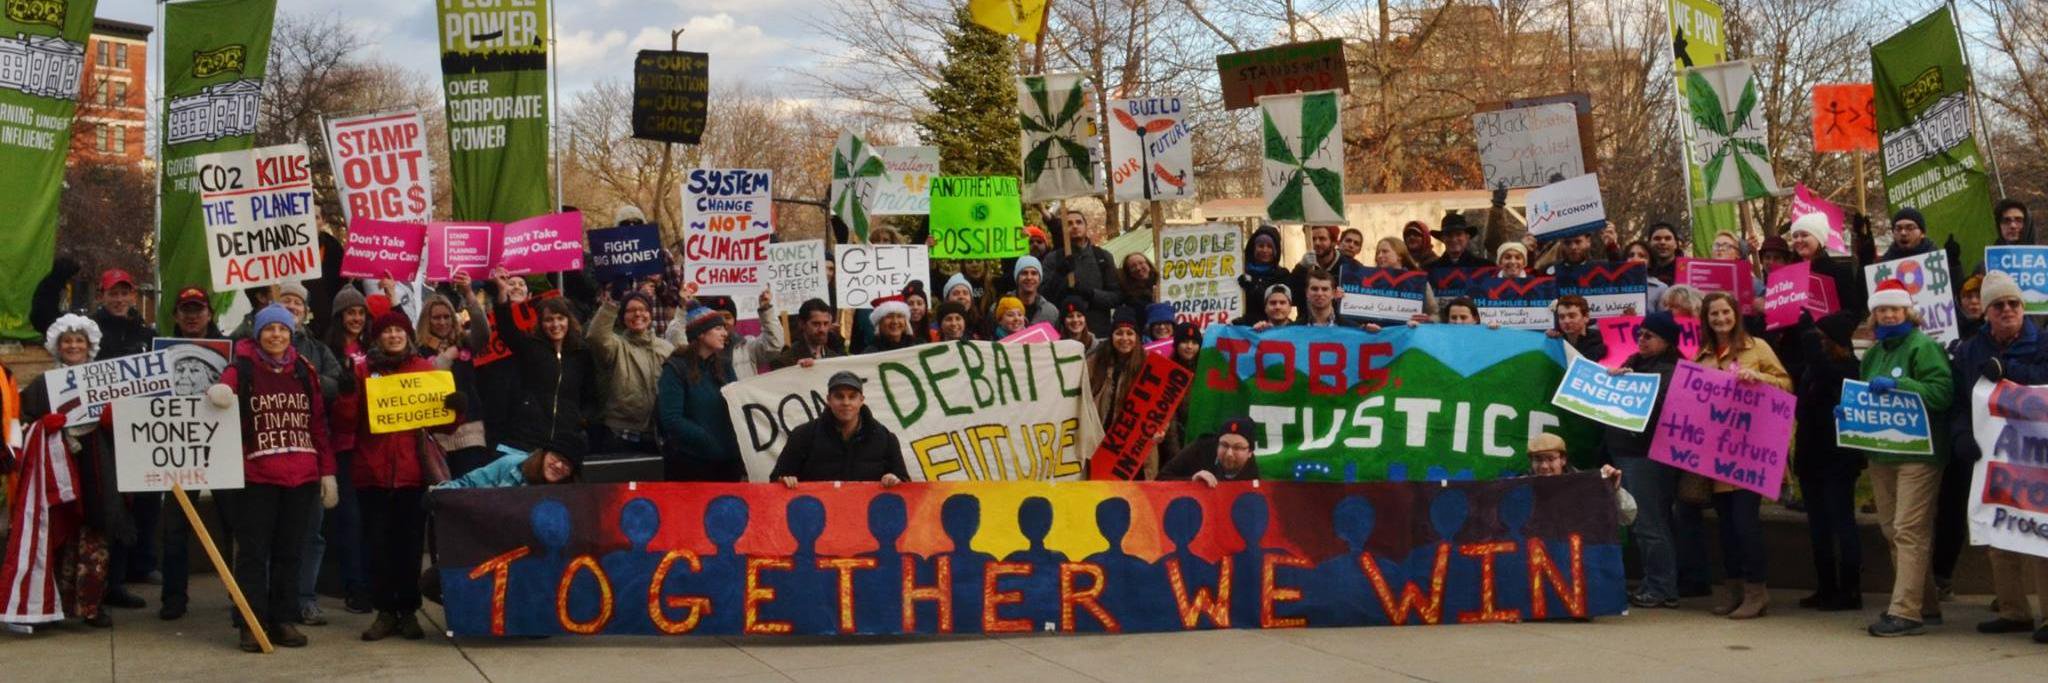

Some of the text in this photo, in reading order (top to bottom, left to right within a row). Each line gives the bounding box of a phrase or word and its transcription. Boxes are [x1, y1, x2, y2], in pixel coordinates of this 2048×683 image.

[445, 10, 538, 49] POWER
[1674, 1, 1718, 46] WE PAY
[657, 56, 692, 71] OUR
[448, 79, 489, 95] OVER
[449, 95, 542, 123] CORPORATE
[1130, 98, 1181, 116] BUILD
[2, 126, 56, 150] INFLUENCE
[336, 122, 419, 158] STAMP
[451, 125, 506, 151] POWER
[1150, 119, 1192, 157] FUTURE
[256, 155, 309, 187] KILLS
[343, 150, 423, 190] OUT
[1113, 158, 1140, 186] OUR
[688, 169, 769, 196] SYSTEM
[931, 177, 992, 198] ANOTHER
[1888, 166, 1942, 204] GOVERNING
[1917, 172, 1969, 210] INFLUENCE
[202, 192, 311, 226] THE PLANET
[696, 197, 754, 213] CHANGE
[975, 205, 986, 220] IS
[1557, 201, 1599, 218] ECONOMY
[708, 216, 752, 232] NOT
[217, 223, 310, 258] DEMANDS
[349, 232, 405, 248] Don't Take
[504, 229, 558, 245] Don't Take
[604, 239, 640, 252] FIGHT
[687, 233, 770, 261] CLIMATE
[931, 226, 1026, 255] POSSIBLE
[1163, 232, 1236, 259] PEOPLE
[346, 246, 377, 262] Away
[379, 249, 398, 261] Our
[502, 240, 582, 258] Away Our Care.
[611, 248, 660, 265] MONEY
[842, 246, 918, 274] GET
[226, 246, 314, 285] ACTION!
[695, 266, 758, 285] CHANGE
[768, 261, 819, 280] SPEECH
[1163, 254, 1236, 280] POWER
[776, 277, 819, 293] SPEECH
[847, 272, 911, 288] MONEY
[1168, 280, 1218, 298] OVER
[1343, 283, 1424, 300] NH FAMILIES NEED
[1579, 286, 1619, 294] FAMILIES
[1620, 284, 1646, 293] NEED
[1164, 296, 1238, 313] ORPORATE
[82, 361, 116, 377] JOIN
[83, 352, 169, 389] THE NH
[86, 378, 171, 404] Rebellion
[400, 377, 421, 389] WE
[1571, 377, 1647, 408] ENERGY
[1593, 372, 1652, 394] CLEAN
[1680, 364, 1766, 406] Together
[151, 397, 202, 418] GET
[249, 391, 310, 413] CAMPAIG
[376, 391, 447, 409] WELCOME
[1103, 364, 1162, 456] KEEP IT
[1141, 368, 1189, 438] GROUND
[1857, 390, 1918, 410] CLEAN
[376, 407, 449, 426] REFUGEES
[1843, 406, 1919, 427] ENERGY
[131, 421, 219, 444] MONEY
[1661, 413, 1778, 466] the future
[152, 445, 212, 468] OUT!
[910, 417, 1082, 481] FUTURE
[469, 531, 1588, 635] TOGETHER WE WIN
